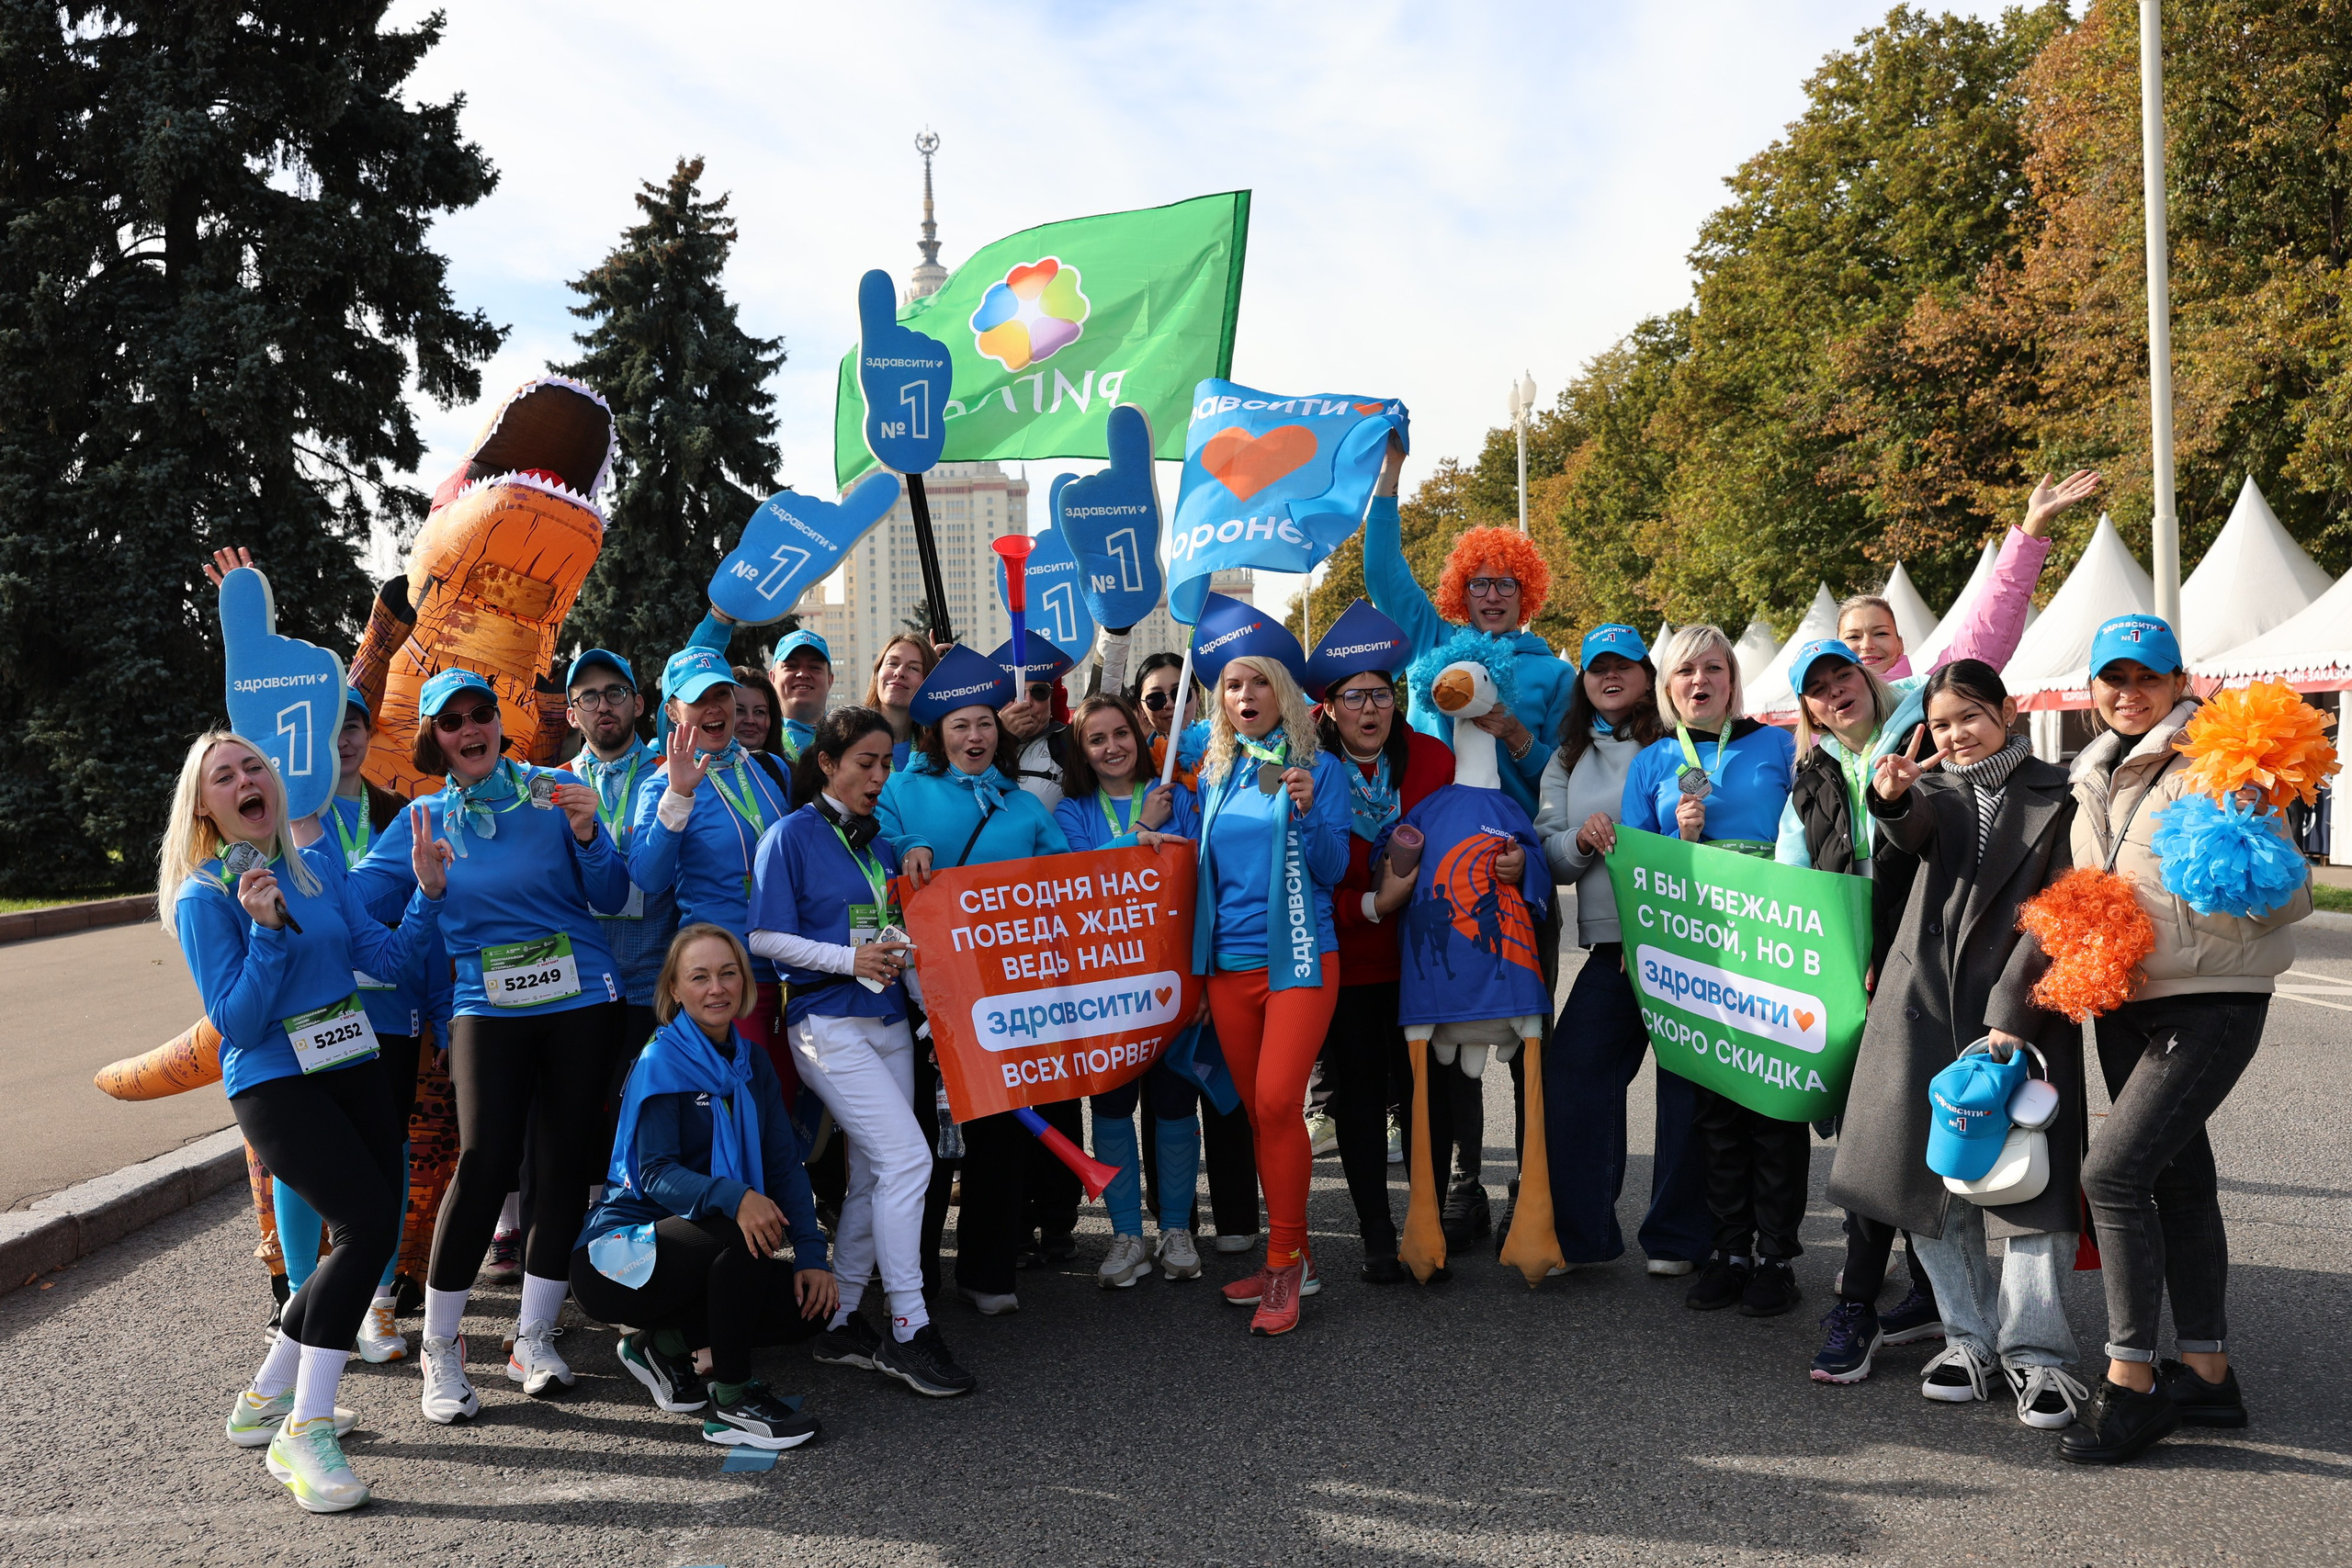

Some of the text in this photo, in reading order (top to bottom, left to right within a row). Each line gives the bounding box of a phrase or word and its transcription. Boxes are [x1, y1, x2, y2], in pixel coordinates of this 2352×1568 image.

[865, 357, 933, 368] здравсити
[769, 503, 830, 548] здравсити
[1065, 505, 1136, 519] здравсити
[1171, 516, 1313, 561] ороне
[1198, 626, 1253, 655] здравсити
[1326, 640, 1392, 659] здравсити
[233, 674, 315, 693] здравсити
[928, 681, 993, 701] здравсити
[959, 868, 1160, 914] СЕГОДНЯ НАС
[1286, 830, 1314, 978] здравсити
[1634, 867, 1825, 937] Я БЫ УБЕЖАЛА
[951, 915, 1069, 952] ПОБЕДА
[1076, 897, 1158, 936] ЖДЁТ
[1637, 905, 1821, 976] С ТОБОЙ, НО В
[504, 968, 561, 992] 52249
[1001, 939, 1145, 981] ВЕДЬ НАШ
[987, 989, 1152, 1039] здравсити
[1645, 960, 1789, 1028] здравсити
[313, 1022, 363, 1049] 52252
[1641, 1007, 1828, 1093] СКОРО СКИДКА
[1001, 1055, 1069, 1089] ВСЕХ
[1073, 1037, 1162, 1075] ПОРВЕТ
[1934, 1091, 1984, 1117] здравсити
